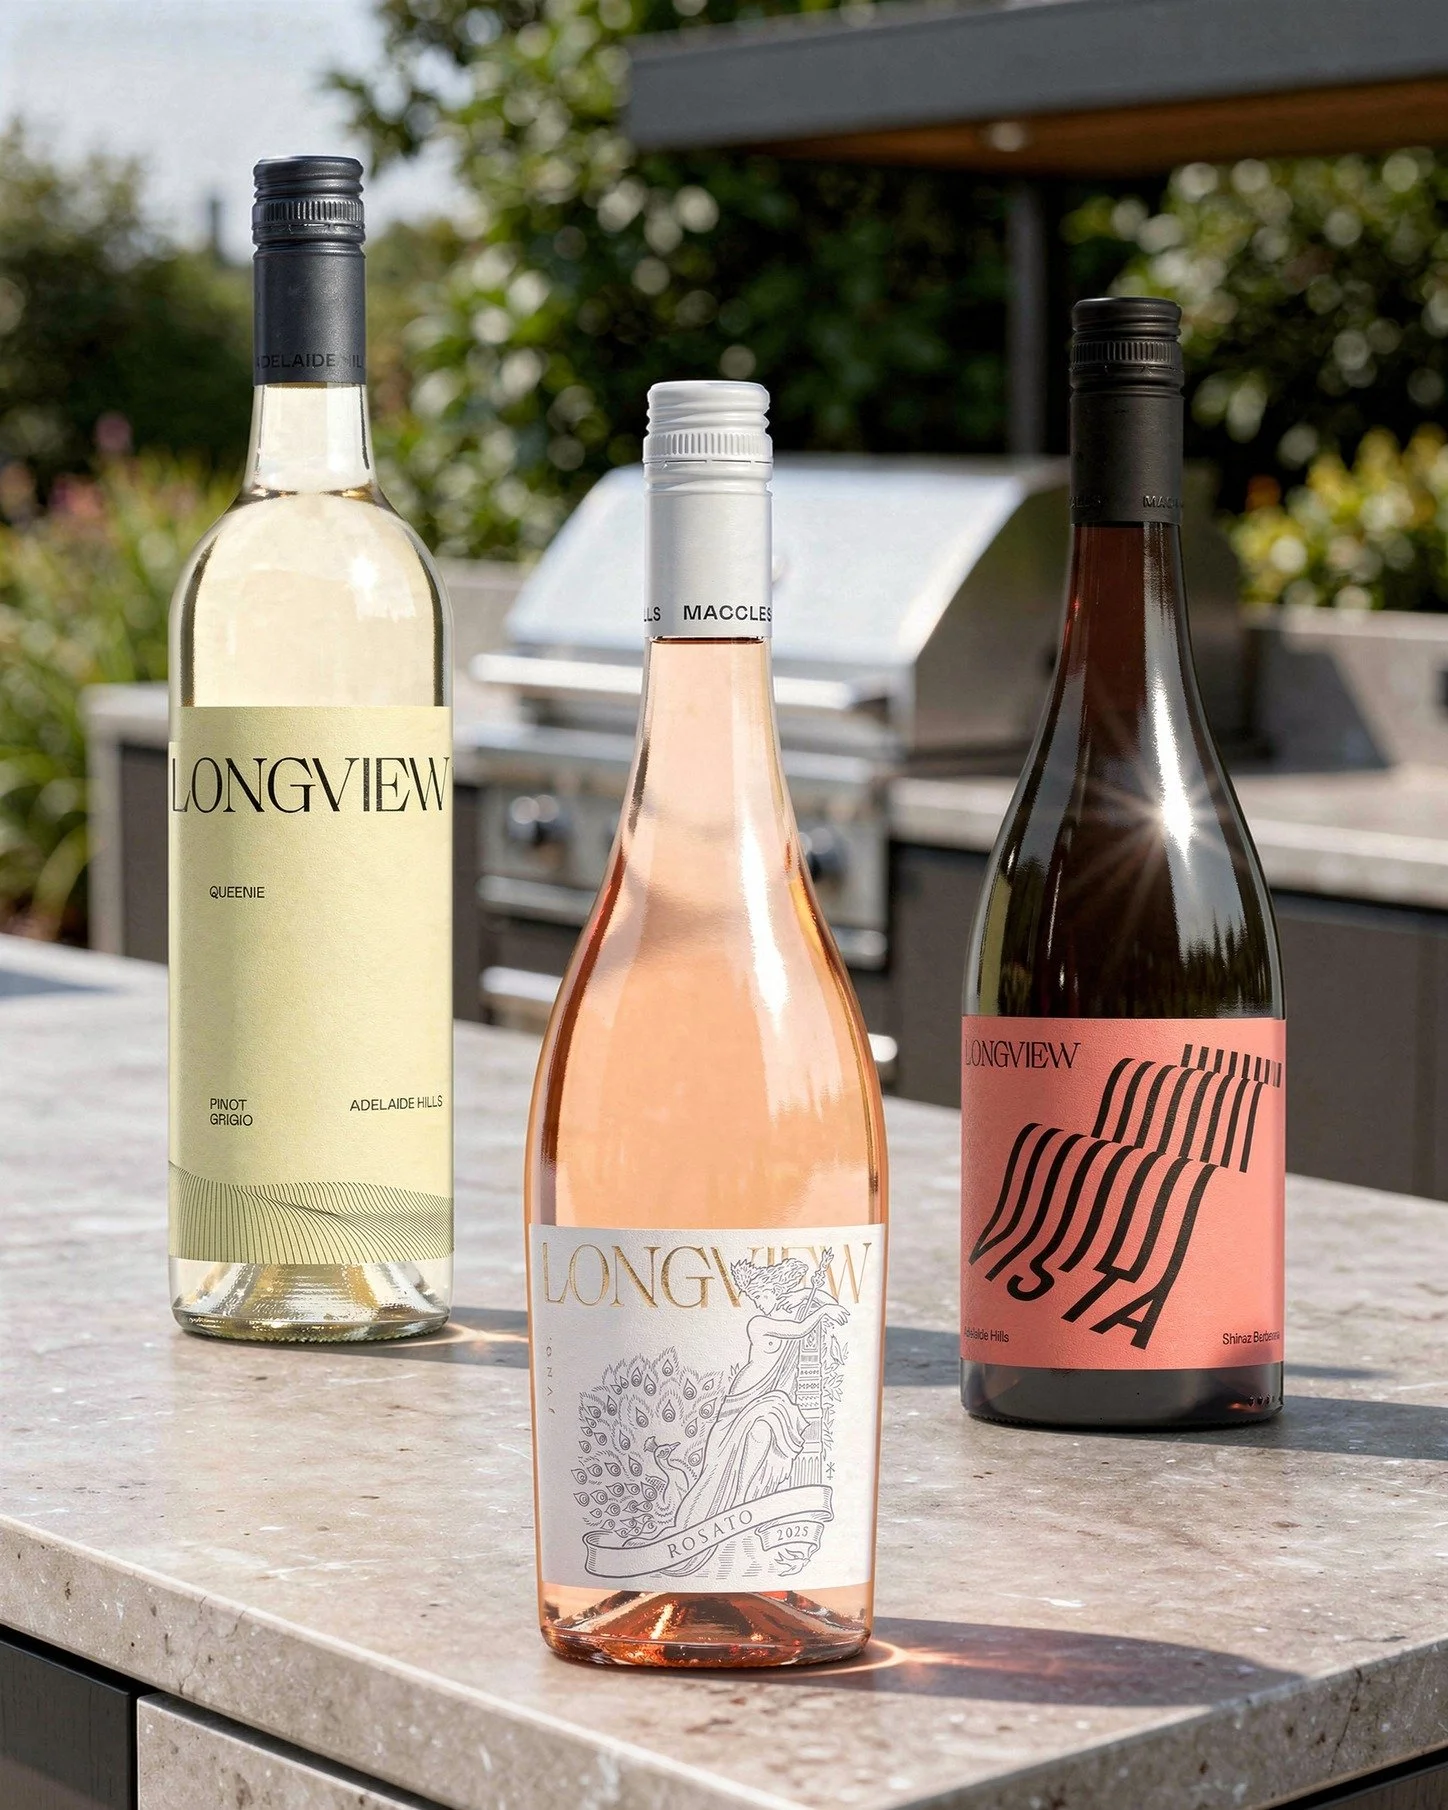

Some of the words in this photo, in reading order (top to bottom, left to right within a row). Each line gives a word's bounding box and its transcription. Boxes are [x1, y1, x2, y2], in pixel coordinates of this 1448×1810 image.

[683, 605, 773, 622] MACCLES
[172, 757, 450, 813] LONGVIEW
[209, 885, 265, 899] QUEENIE
[965, 1039, 1081, 1069] LONGVIEW
[210, 1098, 247, 1111] PINOT
[350, 1097, 415, 1111] ADELAIDE
[417, 1095, 443, 1108] HILLS
[210, 1113, 253, 1126] GRIGIO
[990, 1329, 1010, 1343] Hills
[1222, 1332, 1252, 1346] Shiraz
[667, 1510, 753, 1559] ROSATO
[776, 1526, 809, 1541] 2025
